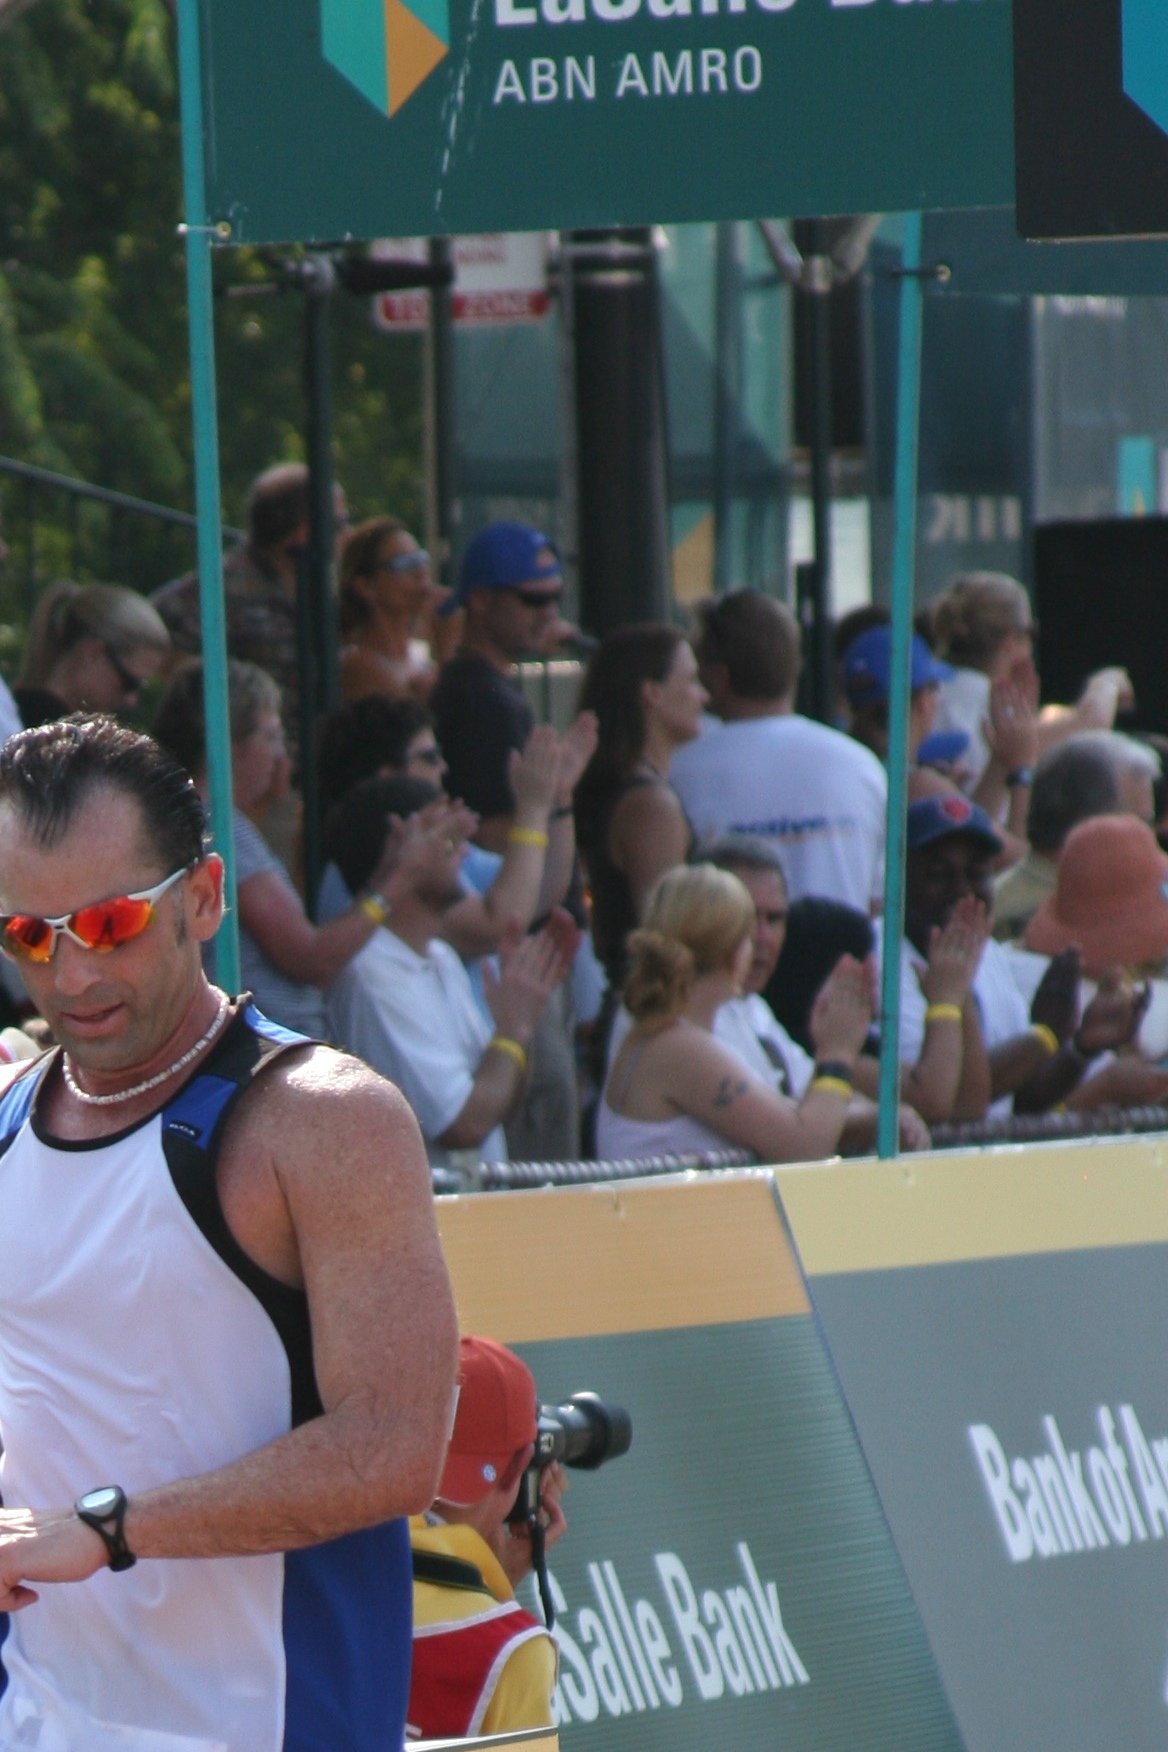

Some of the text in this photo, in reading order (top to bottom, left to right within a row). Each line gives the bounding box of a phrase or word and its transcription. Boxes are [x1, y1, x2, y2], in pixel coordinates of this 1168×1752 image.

[493, 45, 763, 104] ABN AMRO
[655, 1541, 811, 1700] Bank
